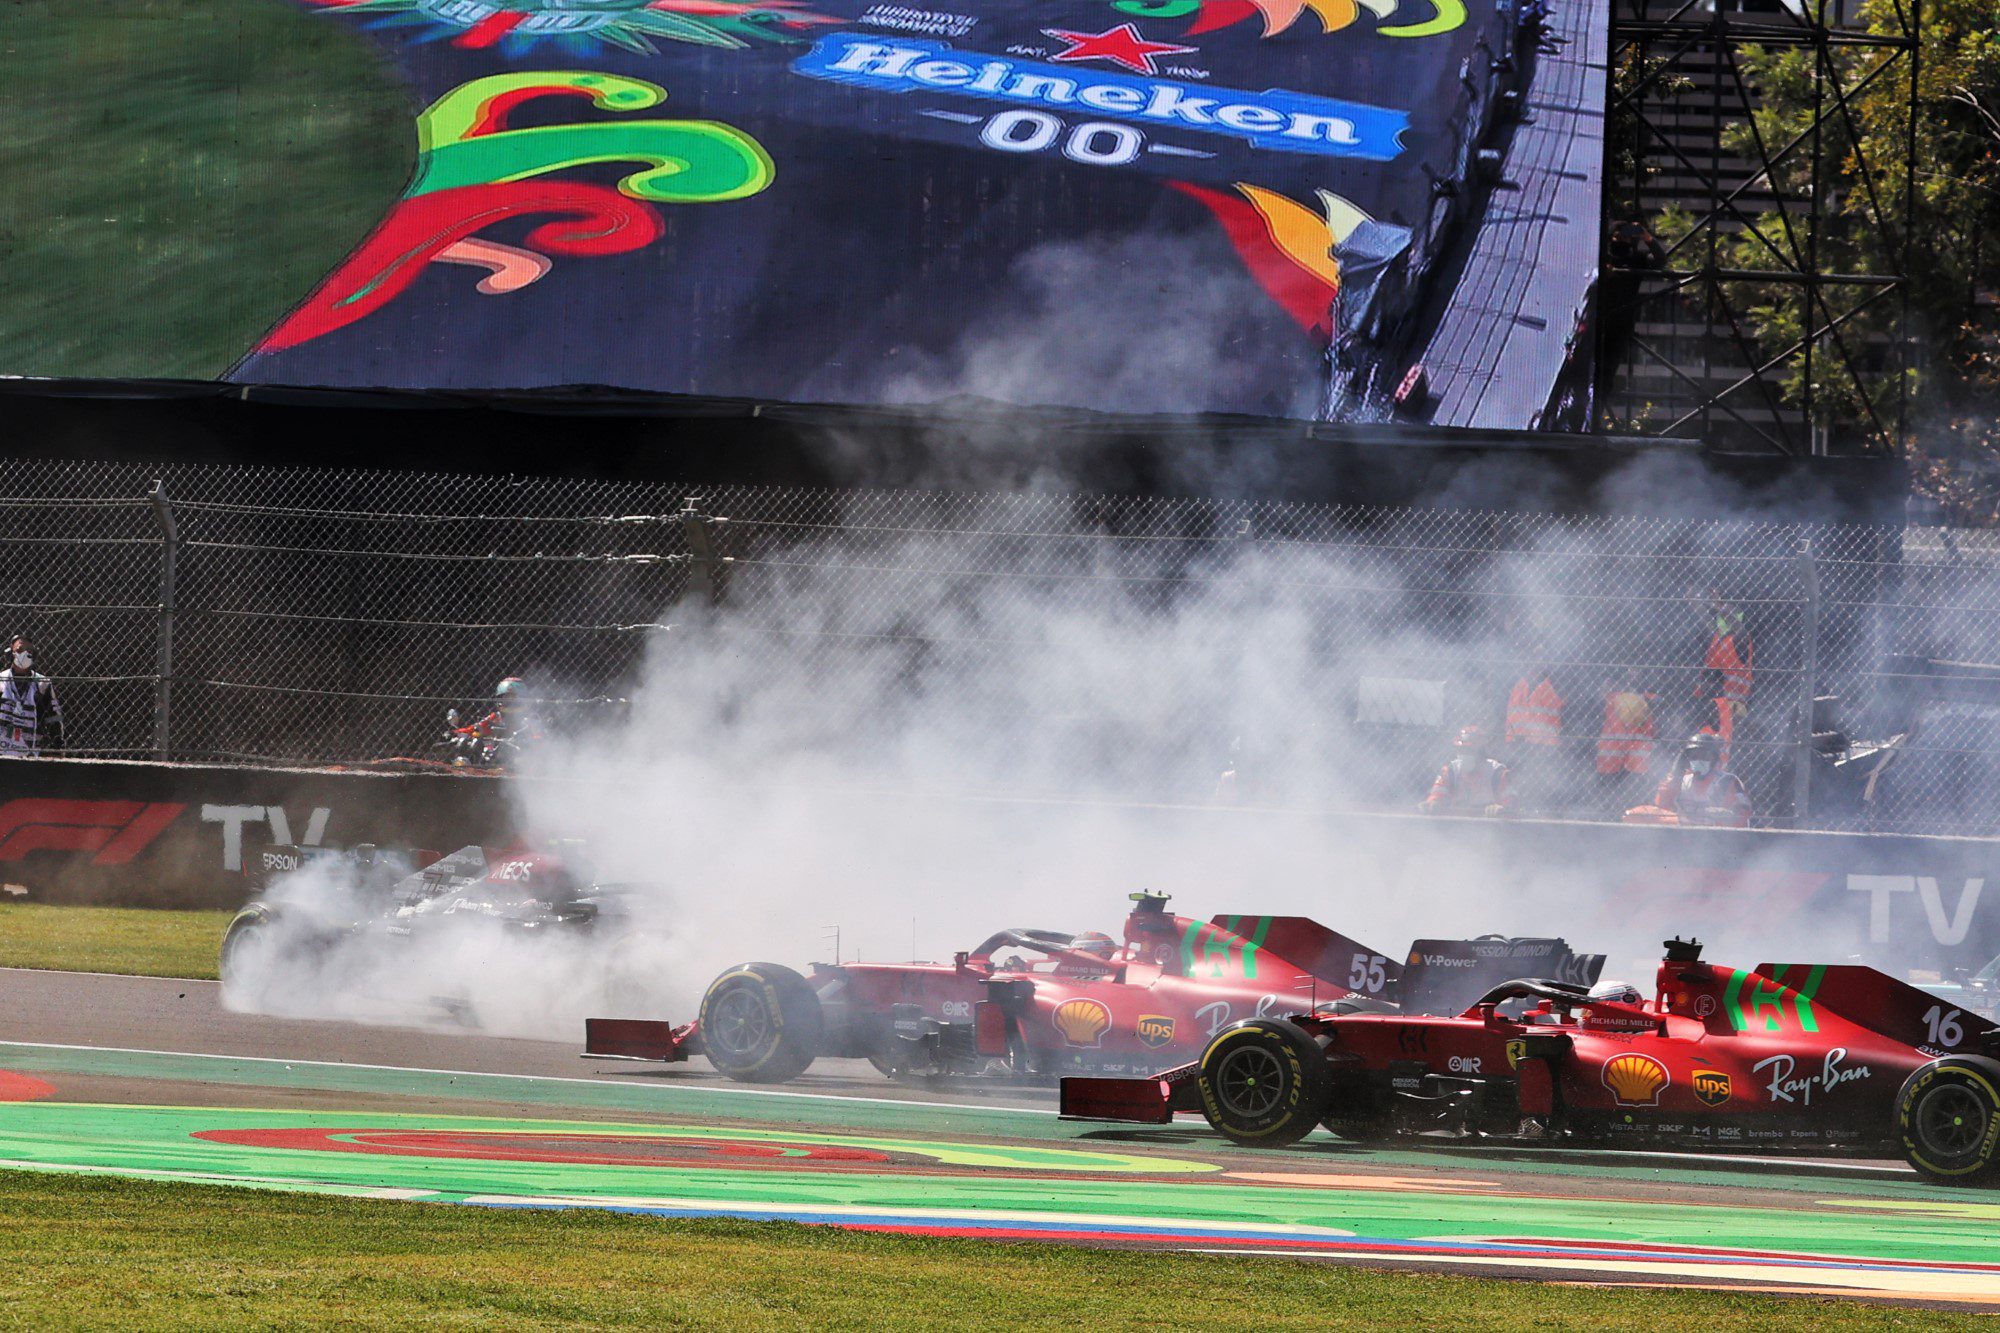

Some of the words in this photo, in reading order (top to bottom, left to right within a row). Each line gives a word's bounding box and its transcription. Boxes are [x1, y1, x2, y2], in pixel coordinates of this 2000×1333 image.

[825, 41, 1361, 146] Heineken
[201, 803, 331, 870] TV
[263, 853, 298, 871] EPSON
[1847, 874, 1985, 946] TV
[1423, 954, 1477, 968] V-Power
[1349, 953, 1386, 993] 55
[1140, 1021, 1172, 1042] ups
[1591, 1017, 1628, 1026] RICHARD
[1629, 1019, 1656, 1028] MILLE
[1922, 1005, 1964, 1047] 16
[1695, 1078, 1730, 1100] ups
[1658, 1124, 1685, 1132] SKF
[1717, 1127, 1742, 1136] NGK
[1748, 1129, 1783, 1138] brembo
